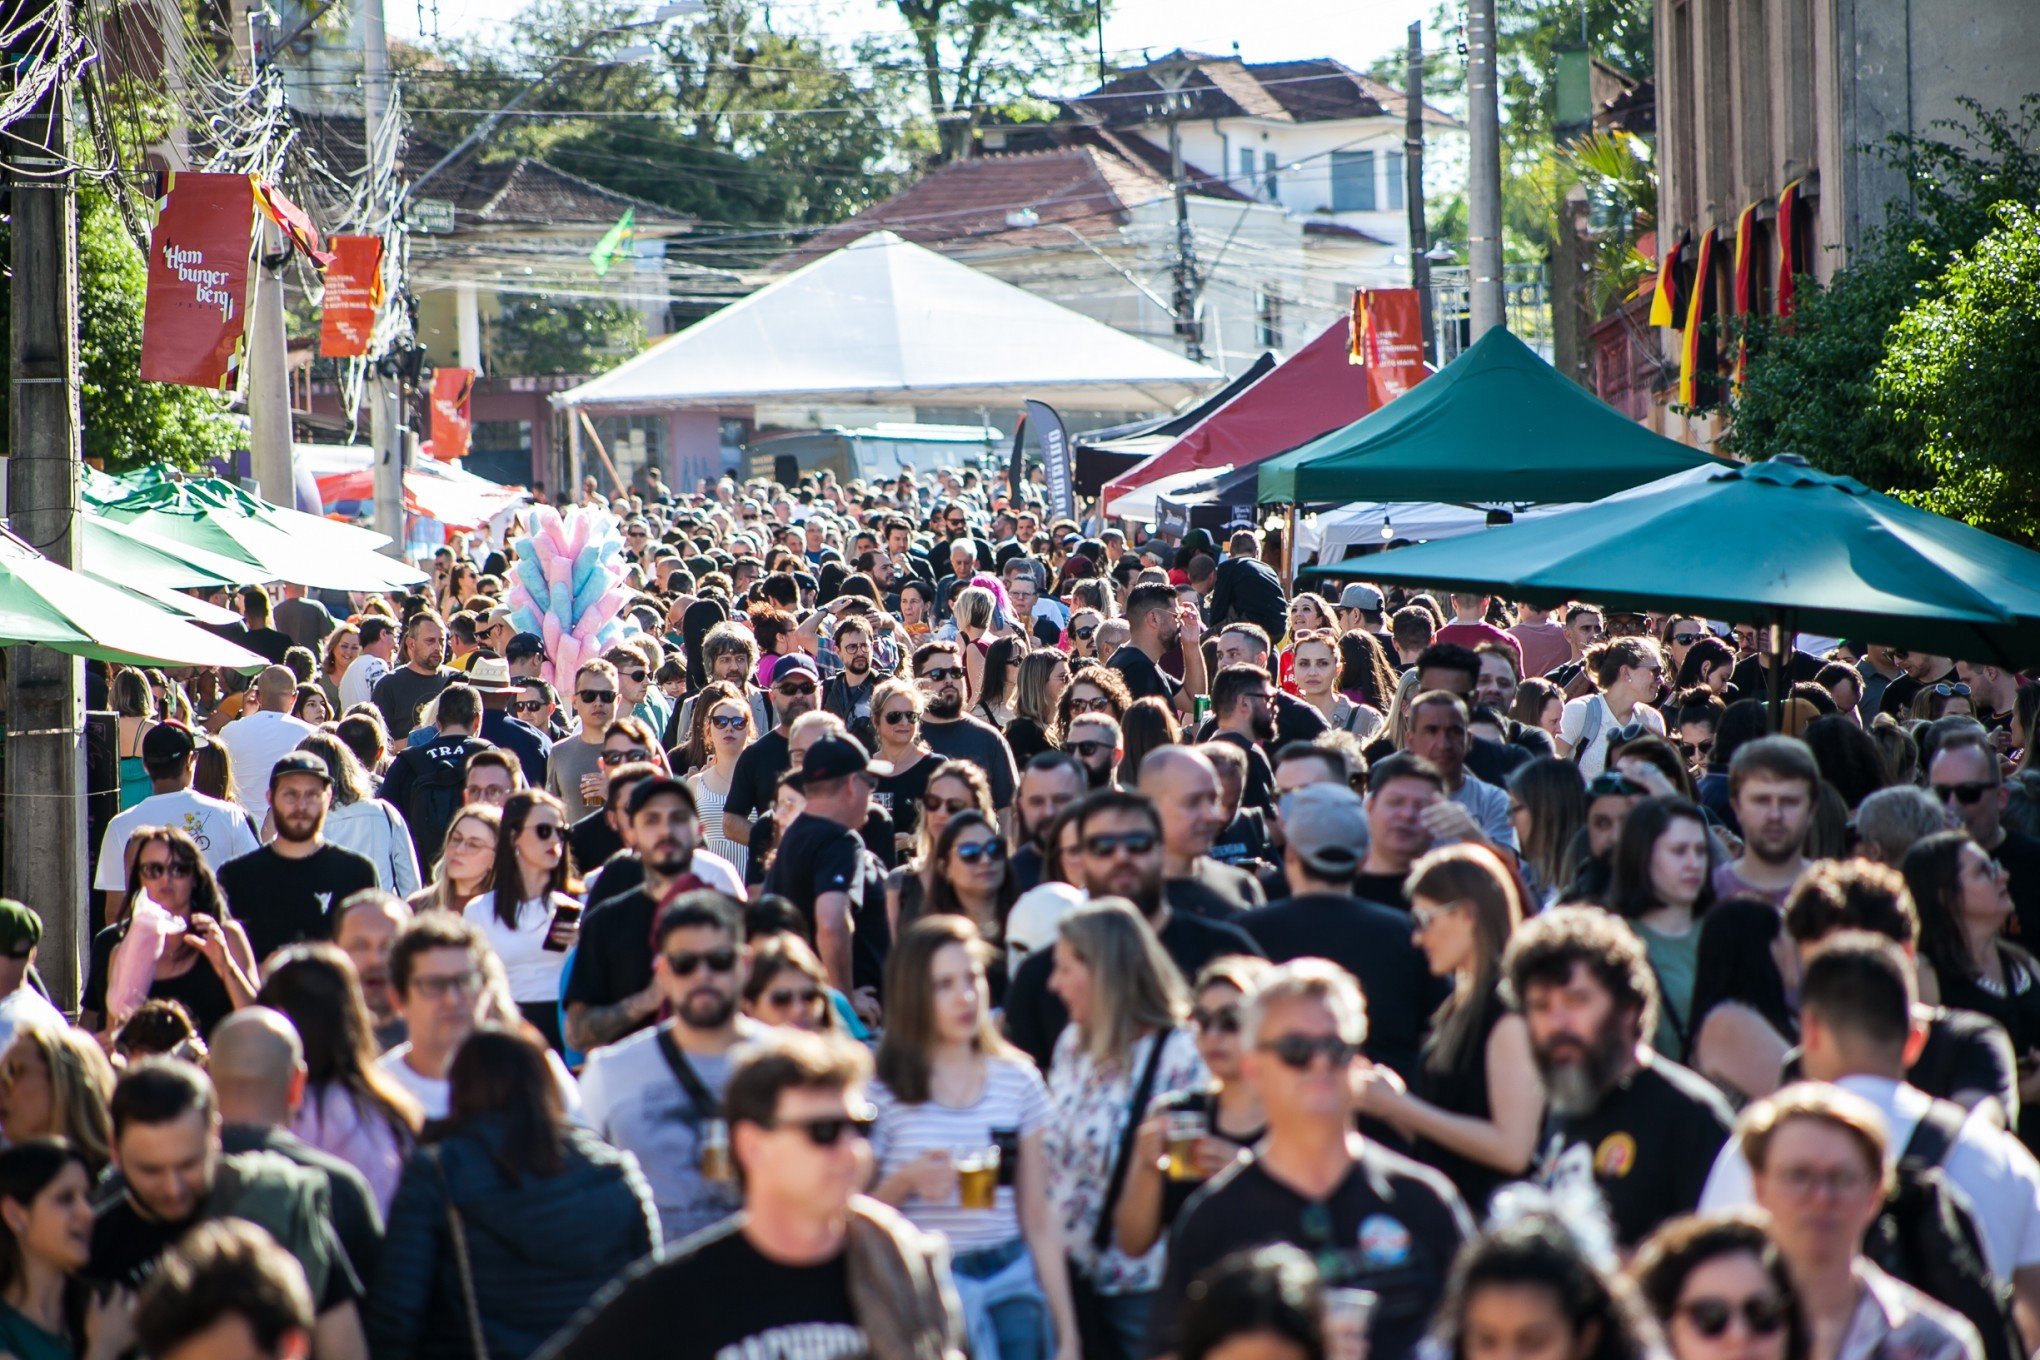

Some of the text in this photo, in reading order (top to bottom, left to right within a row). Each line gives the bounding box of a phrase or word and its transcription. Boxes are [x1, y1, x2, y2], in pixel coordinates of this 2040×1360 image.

[163, 244, 203, 269] Ham
[178, 263, 229, 290] burger
[196, 282, 234, 324] berg
